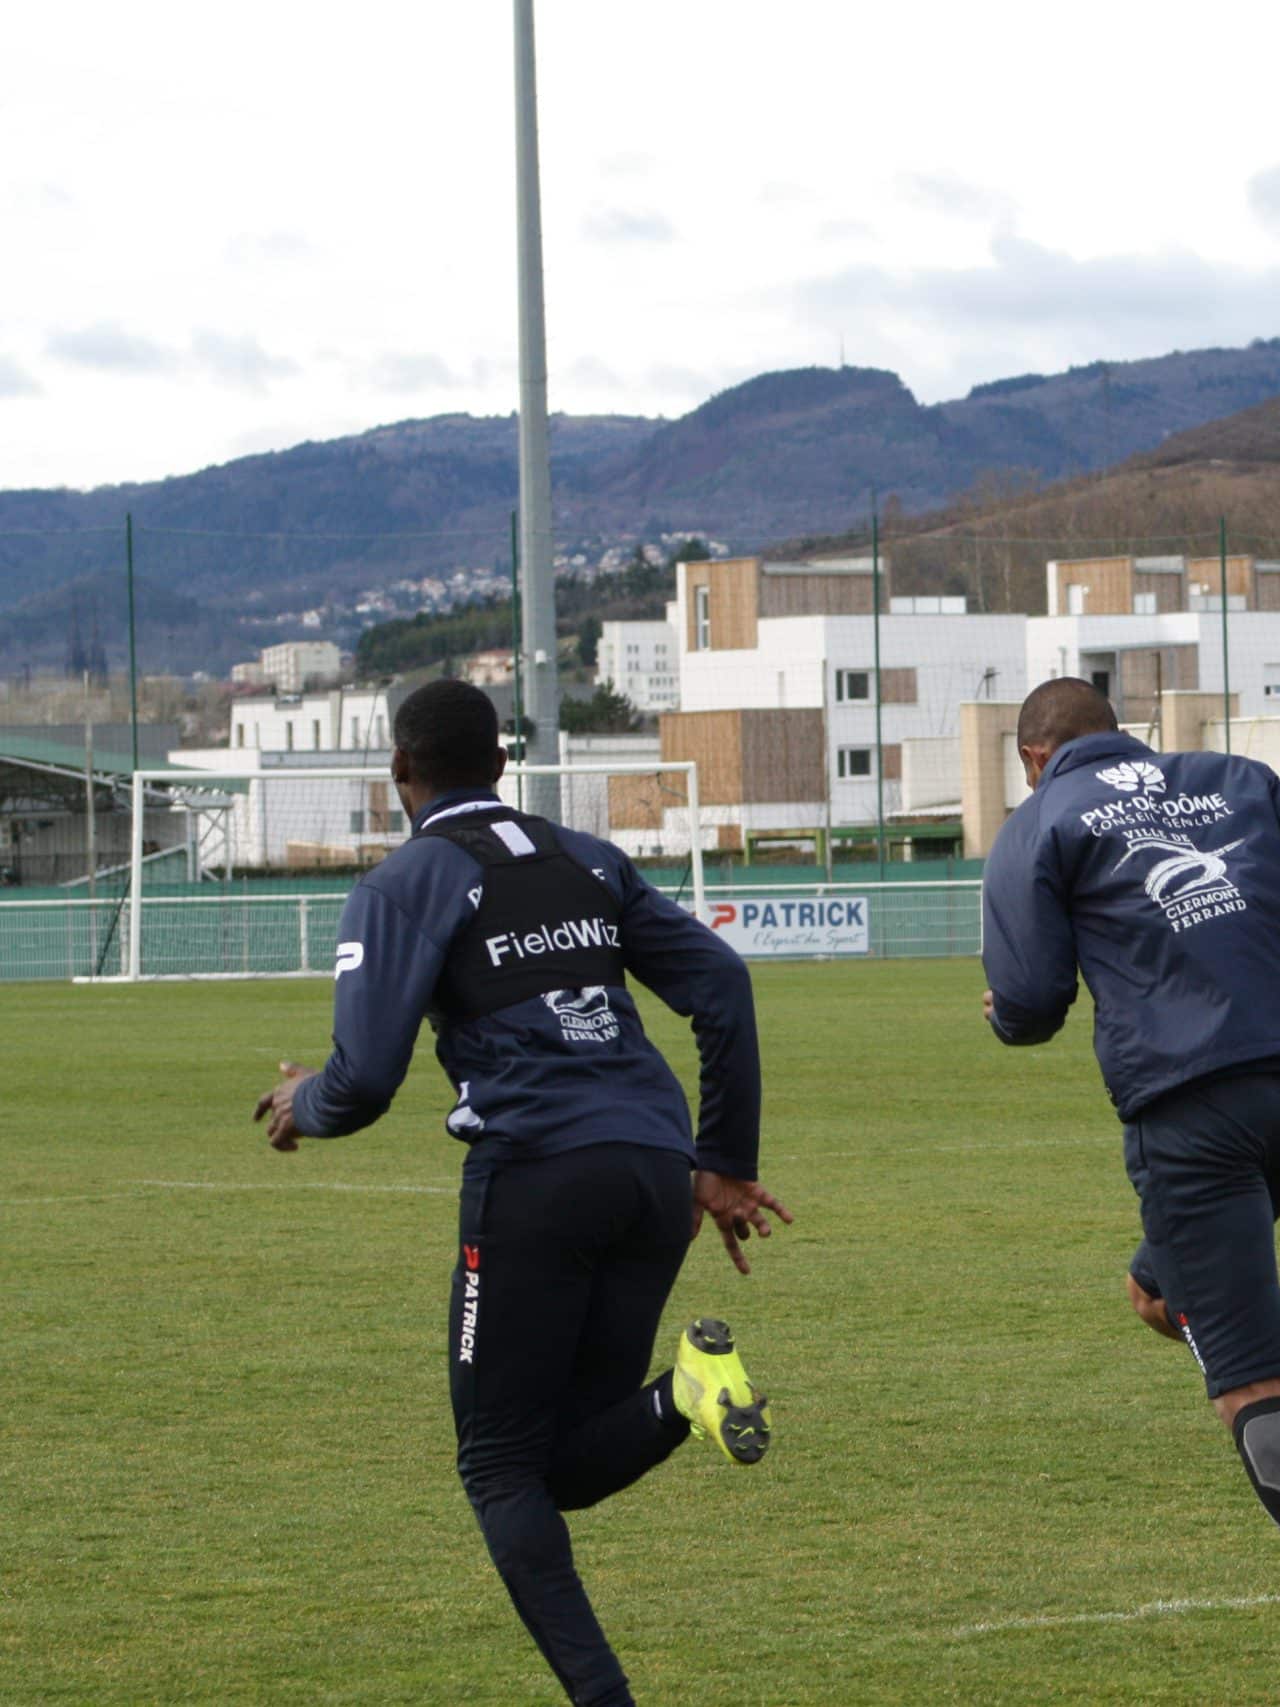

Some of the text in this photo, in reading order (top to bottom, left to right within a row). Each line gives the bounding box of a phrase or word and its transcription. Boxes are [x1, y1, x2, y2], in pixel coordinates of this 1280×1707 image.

[1123, 827, 1191, 843] VILLE DE
[742, 901, 864, 929] PATRICK
[1165, 887, 1241, 920] CLERMONT
[1170, 899, 1248, 933] FERRAND
[485, 918, 622, 968] FieldWiz
[460, 1271, 480, 1364] PATRICK
